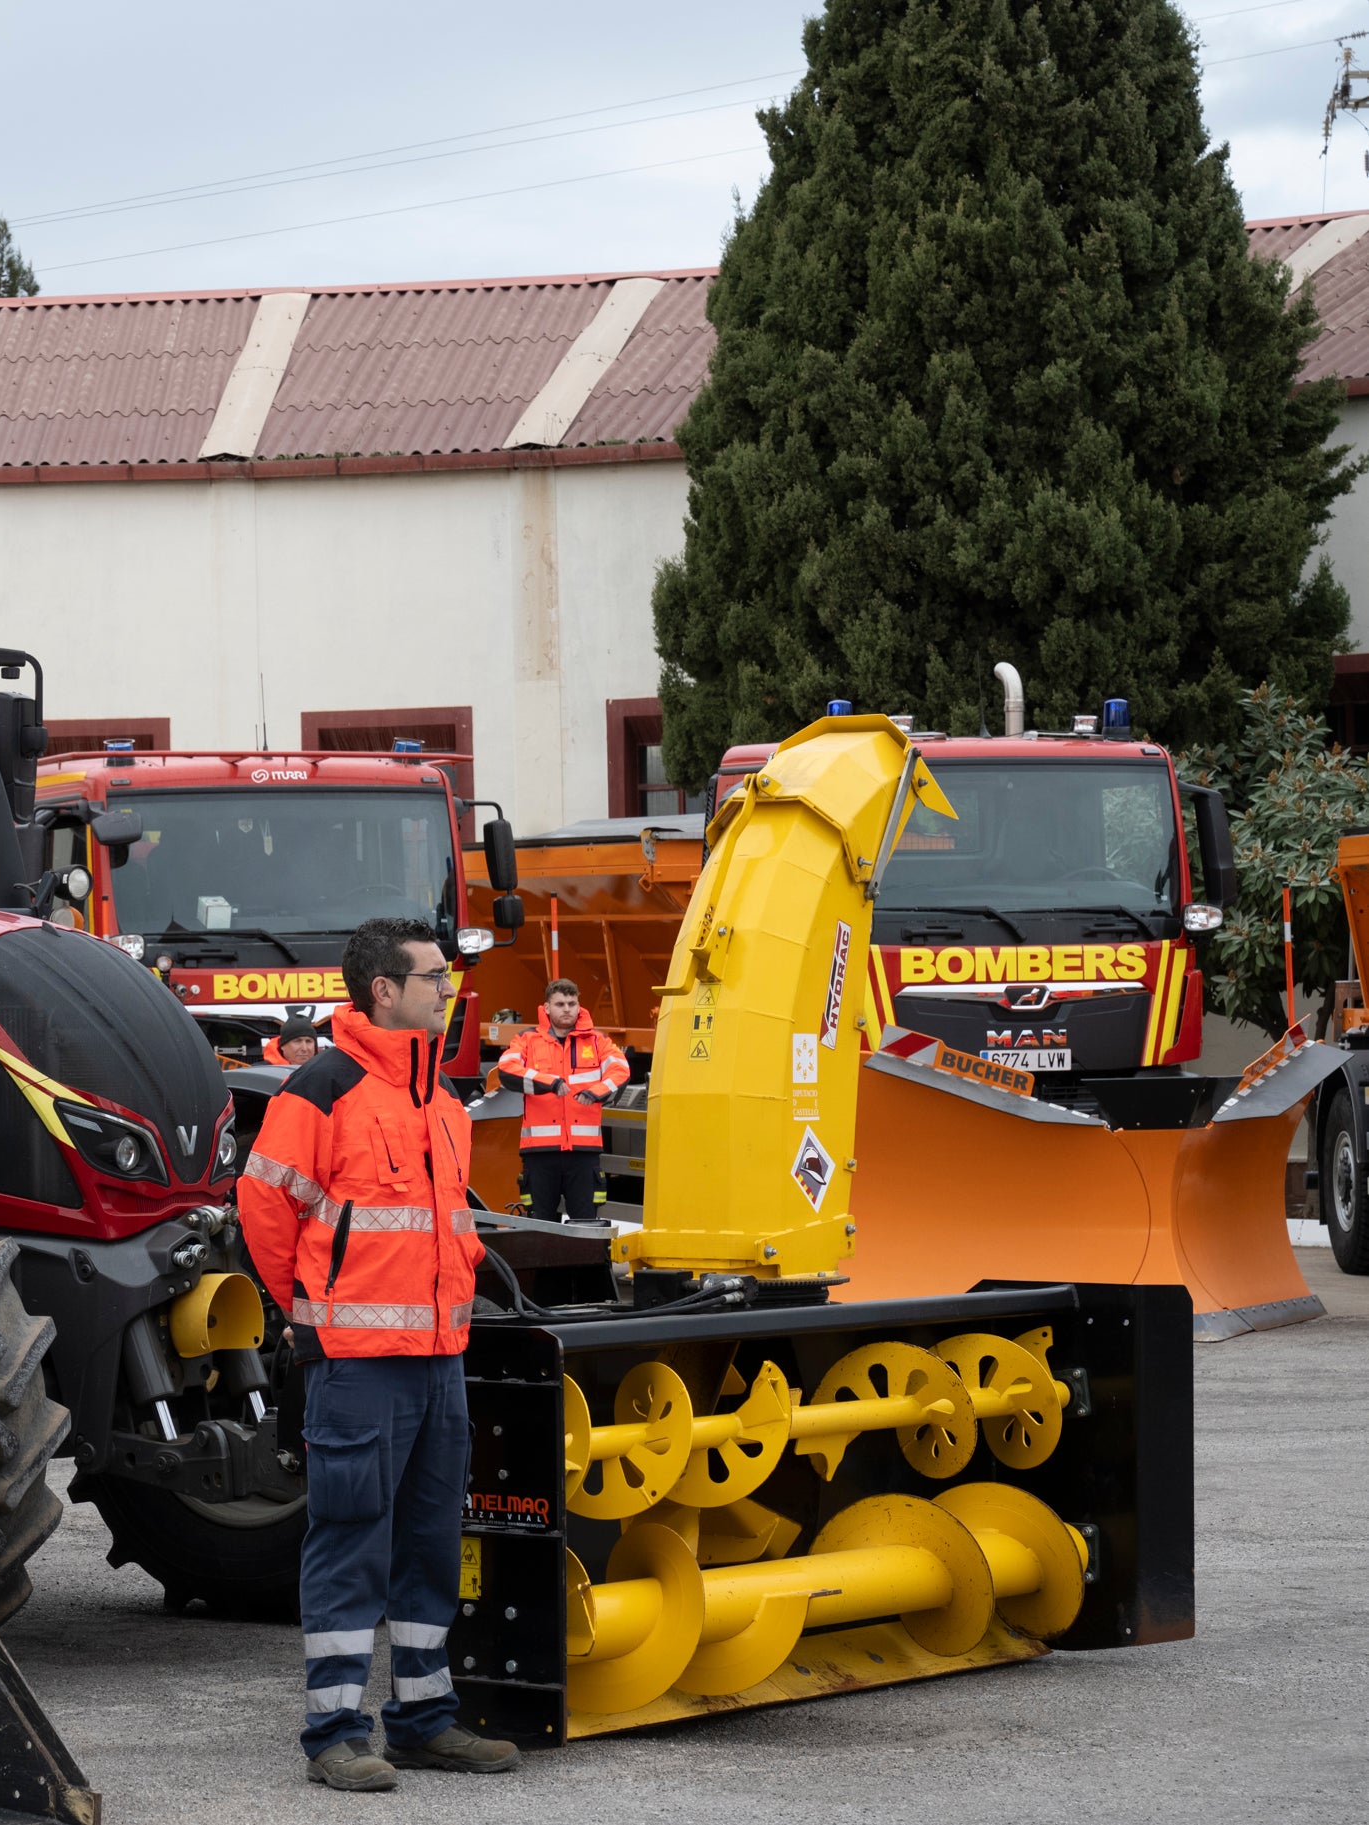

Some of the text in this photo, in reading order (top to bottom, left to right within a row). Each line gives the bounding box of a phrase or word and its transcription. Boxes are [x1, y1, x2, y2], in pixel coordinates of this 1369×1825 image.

[271, 770, 308, 780] ITURRI
[900, 944, 1148, 983] BOMBERS
[213, 972, 349, 1000] BOMBE
[830, 929, 850, 1029] HYDRAC
[986, 1028, 1067, 1048] MAN
[941, 1051, 1029, 1091] BUCHER
[992, 1052, 1066, 1069] 6774 LVW
[507, 1513, 543, 1523] VIAL
